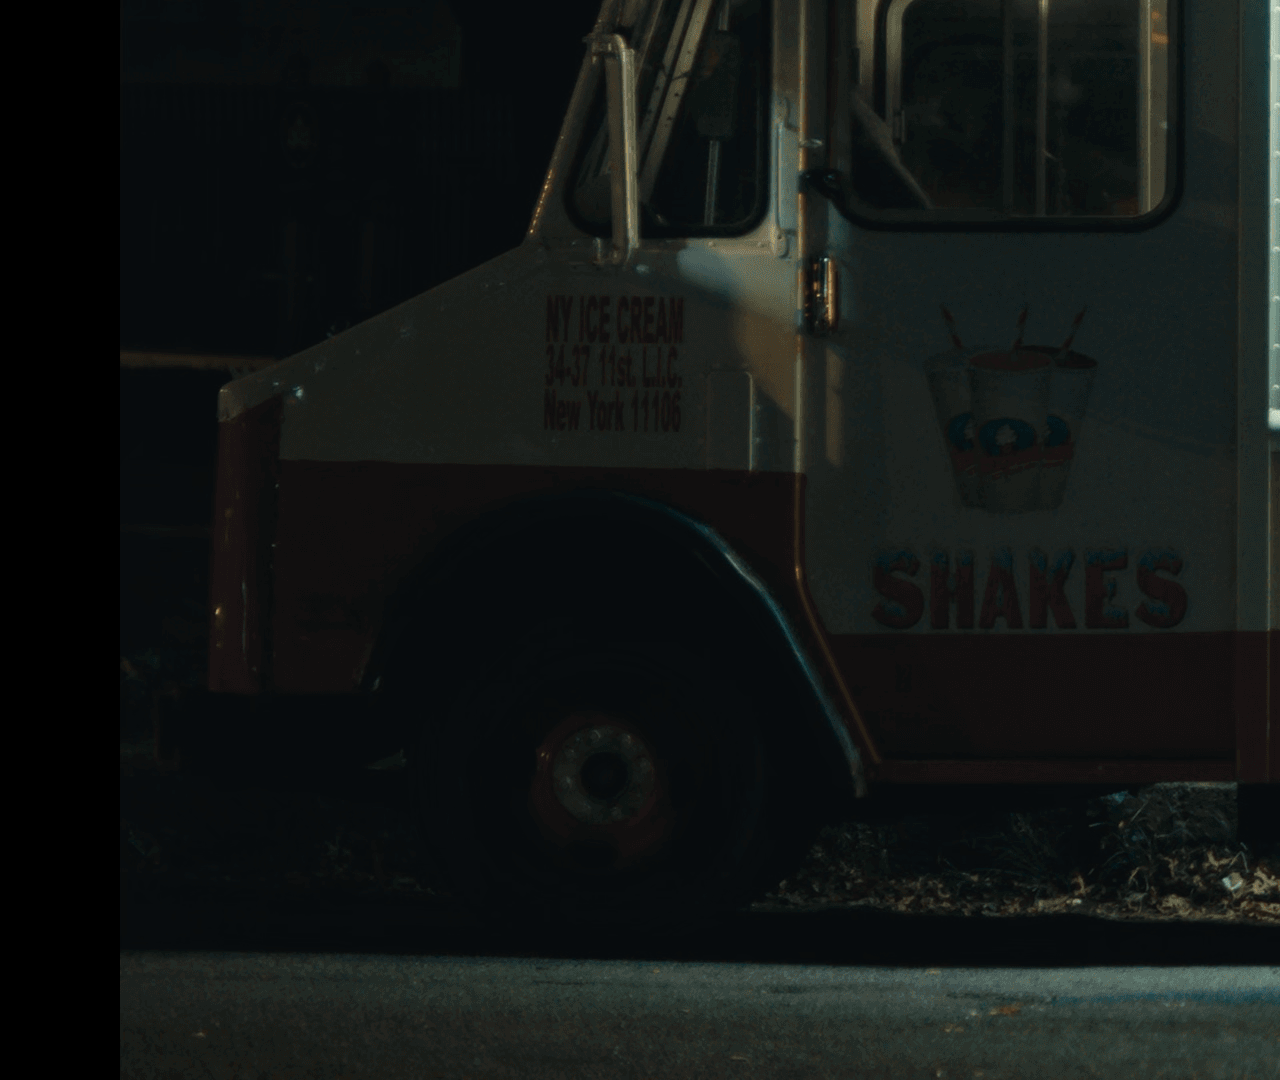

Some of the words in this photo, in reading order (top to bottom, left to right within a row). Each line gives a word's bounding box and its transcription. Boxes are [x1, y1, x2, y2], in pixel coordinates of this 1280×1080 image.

[545, 294, 574, 343] NY
[578, 294, 611, 344] ICE
[616, 295, 685, 344] CREAM
[544, 343, 591, 388] 34-37
[543, 388, 582, 432] New
[586, 389, 626, 433] York
[630, 389, 682, 433] 11106
[870, 544, 1189, 631] SHAKES
